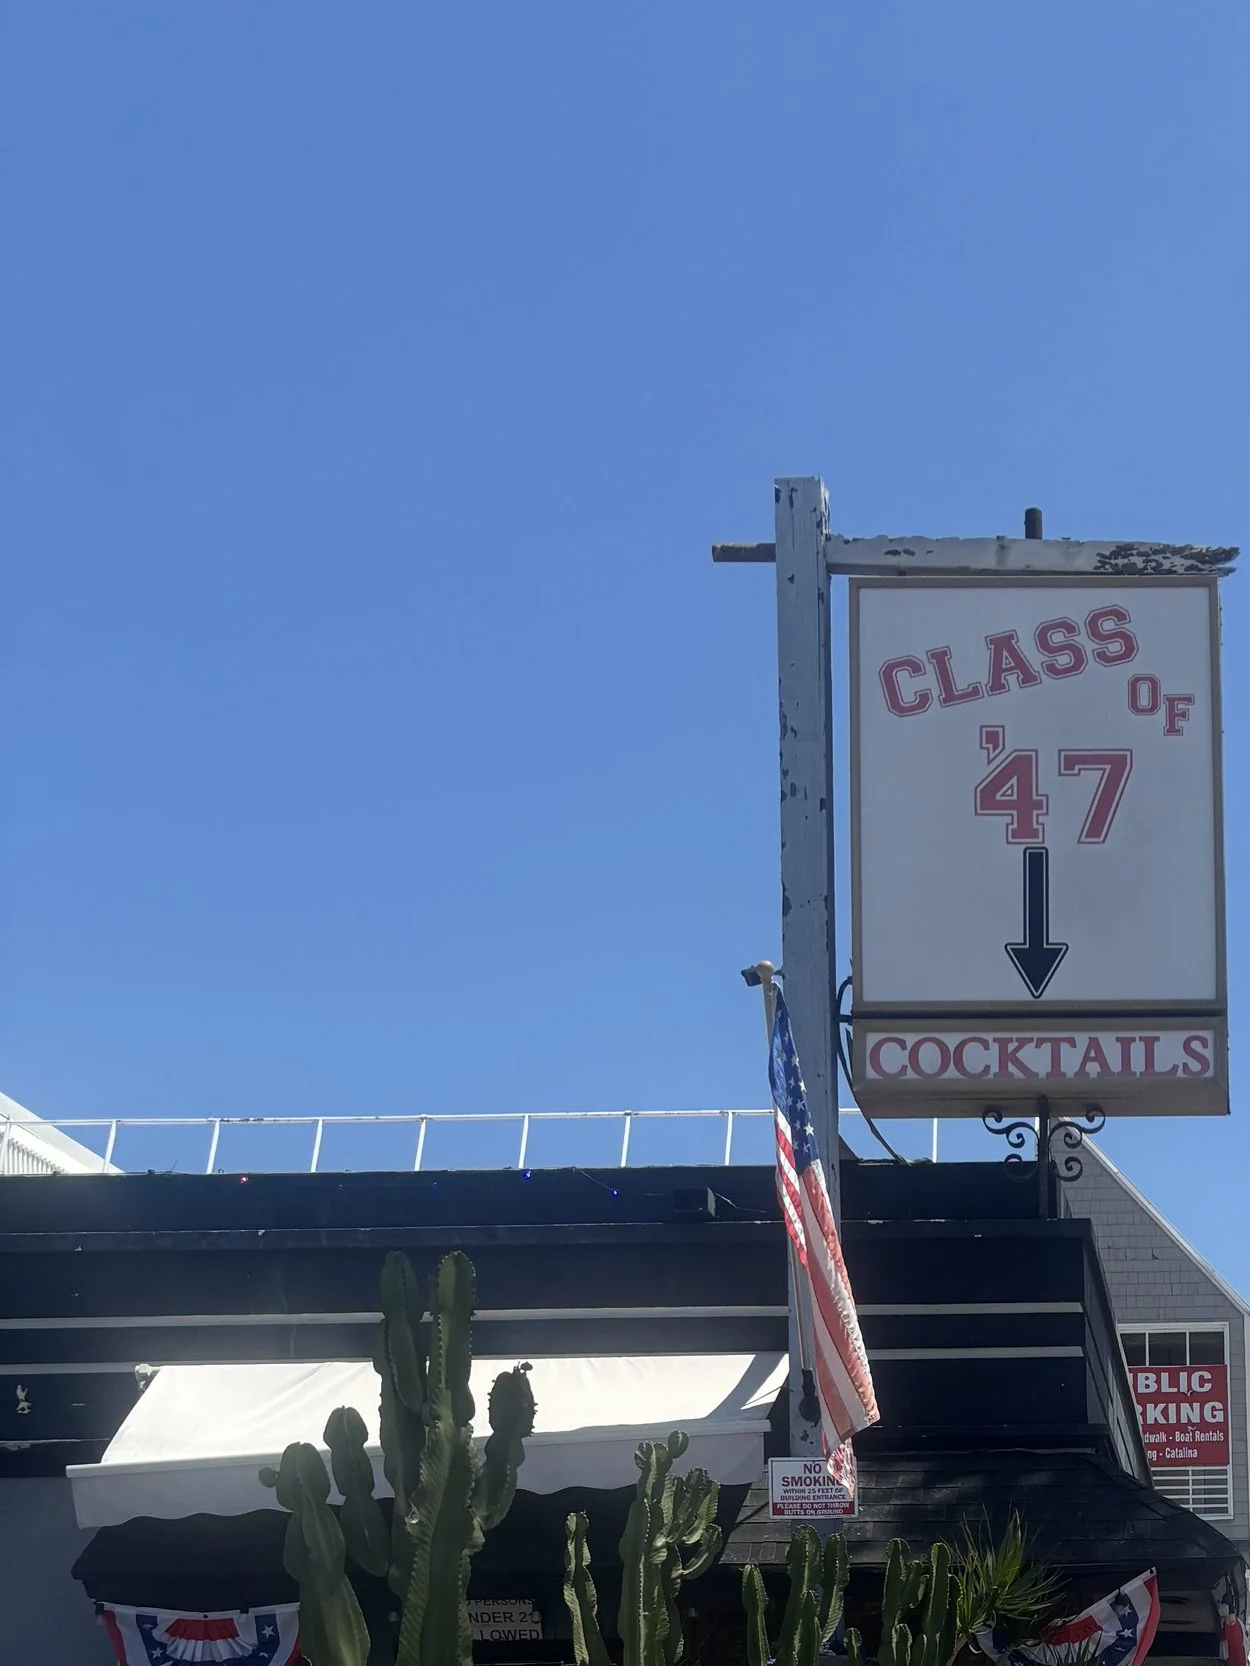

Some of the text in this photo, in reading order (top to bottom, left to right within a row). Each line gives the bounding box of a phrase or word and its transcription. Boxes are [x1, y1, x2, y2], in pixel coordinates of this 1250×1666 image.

[879, 604, 1194, 737] CLASS OF
[974, 724, 1133, 845] '47
[868, 1034, 1212, 1079] COCKTAILS
[1130, 1370, 1212, 1393] BLIC
[1144, 1431, 1167, 1443] dwalk
[1175, 1430, 1193, 1442] Boat
[1195, 1430, 1224, 1442] Rentals
[1165, 1447, 1198, 1459] Catalina
[803, 1463, 822, 1474] NO
[781, 1476, 842, 1487] SMOKIN
[468, 1611, 514, 1624] NDER
[480, 1629, 540, 1641] LOWED
